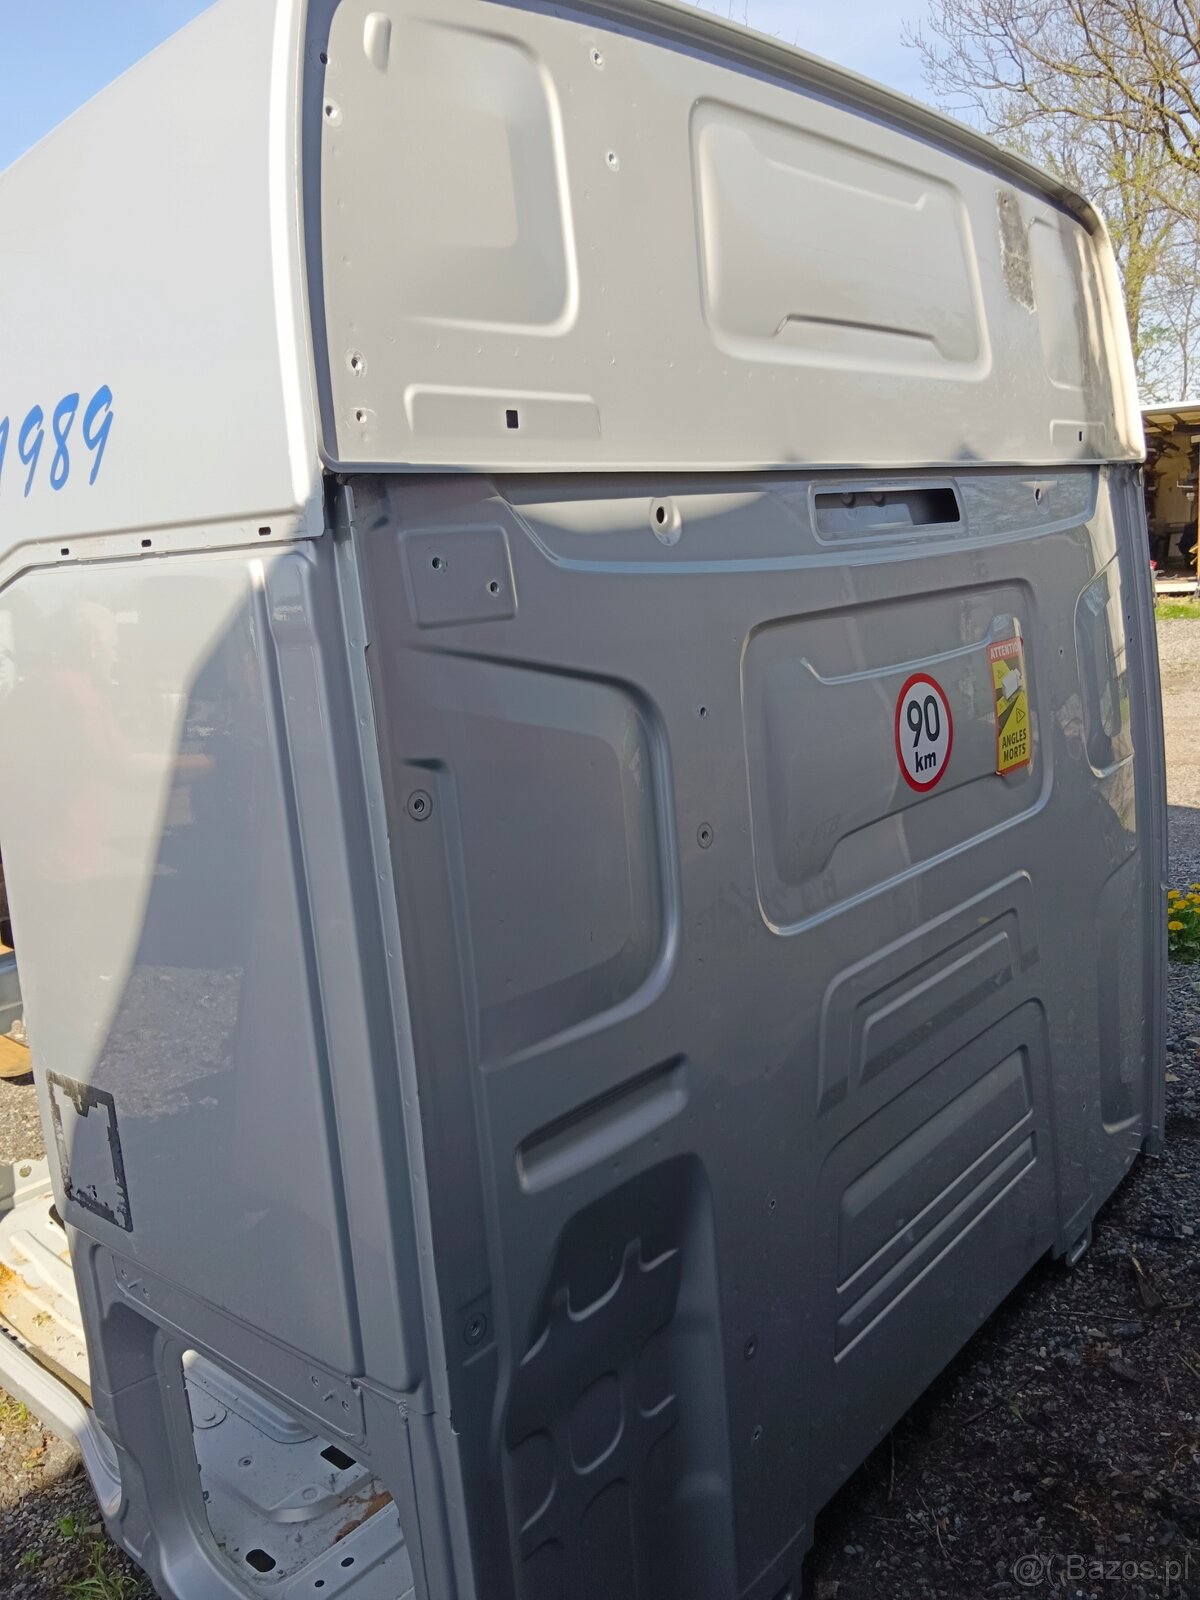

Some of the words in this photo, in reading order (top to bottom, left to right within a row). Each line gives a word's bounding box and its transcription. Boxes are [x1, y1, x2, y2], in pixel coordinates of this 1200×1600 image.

[907, 695, 940, 748] 90
[1002, 728, 1027, 749] ANGLES
[915, 751, 936, 773] km
[1003, 743, 1026, 763] MORTS
